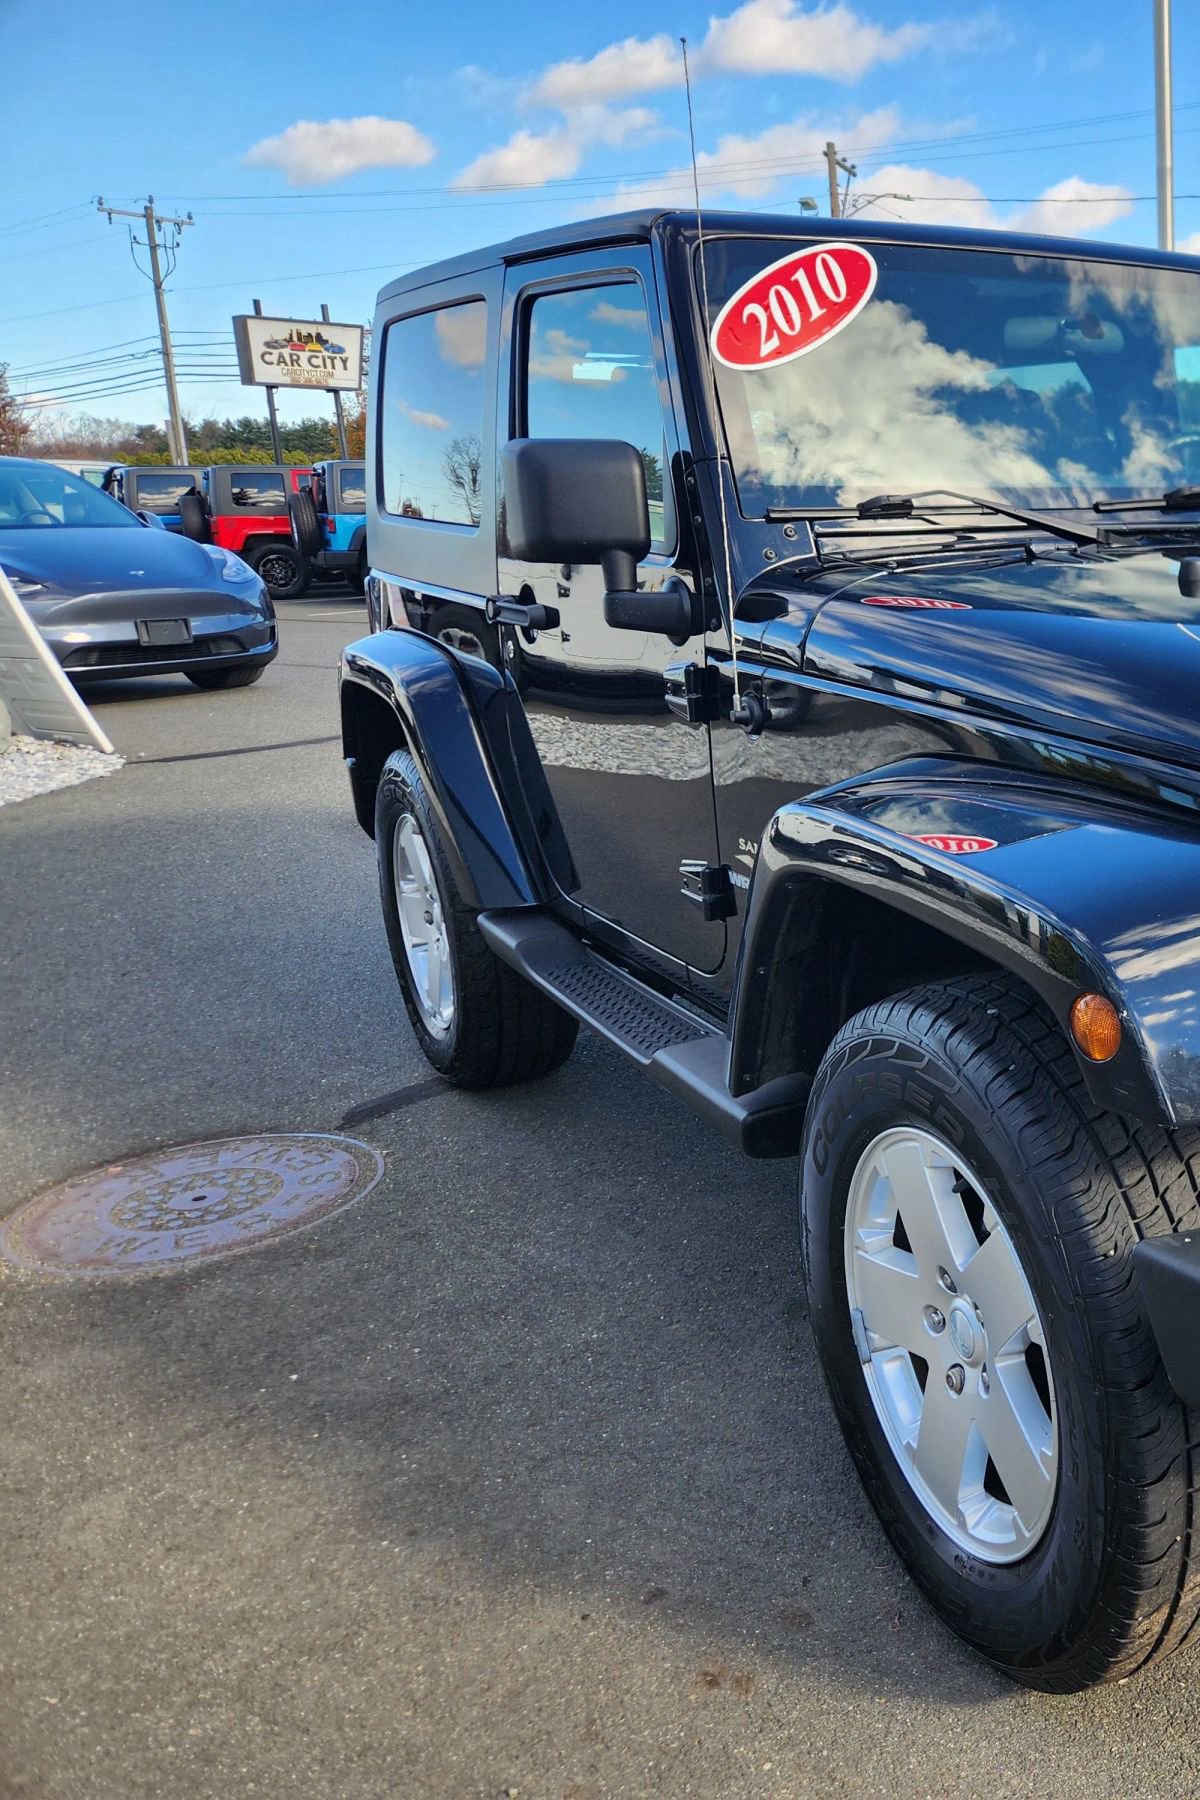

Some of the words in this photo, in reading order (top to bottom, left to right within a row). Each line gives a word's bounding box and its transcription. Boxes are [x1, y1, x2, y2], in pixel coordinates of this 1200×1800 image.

[743, 253, 847, 358] 2010
[260, 351, 302, 367] CAR
[307, 355, 350, 371] CITY
